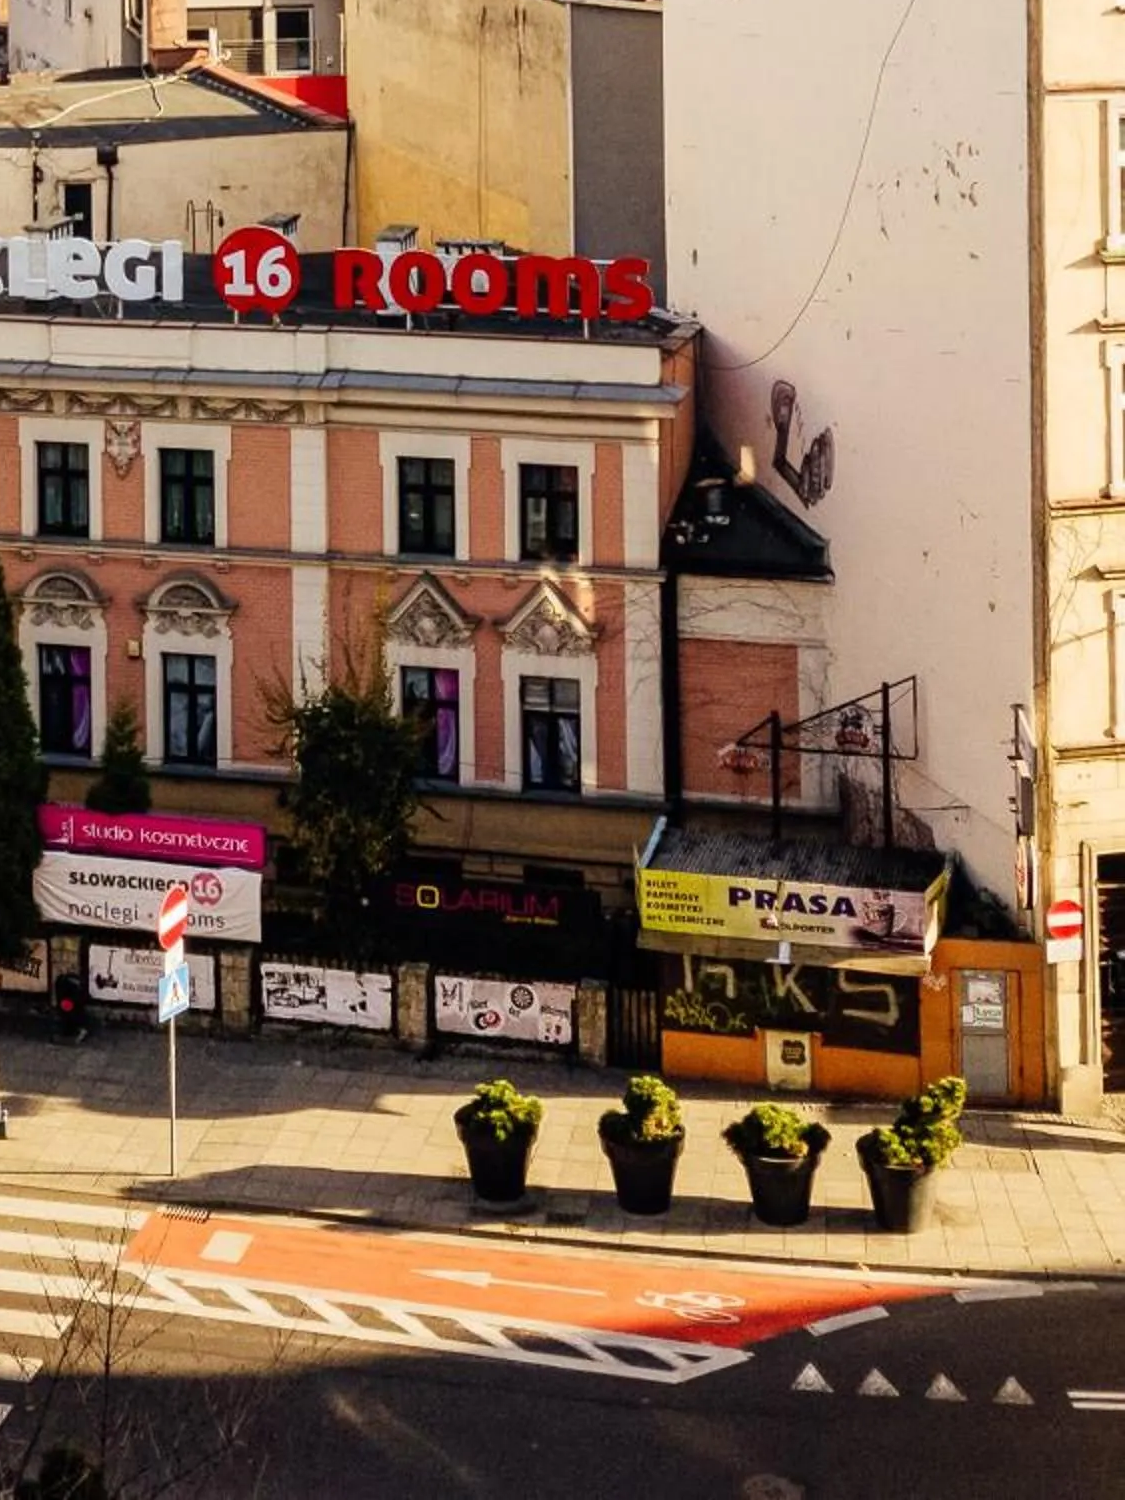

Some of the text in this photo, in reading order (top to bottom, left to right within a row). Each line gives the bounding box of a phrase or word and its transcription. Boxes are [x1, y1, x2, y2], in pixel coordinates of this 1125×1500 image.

[222, 245, 292, 297] 16
[81, 823, 134, 842] studio
[193, 879, 220, 898] 16
[395, 883, 559, 918] SOLARIUM
[68, 900, 139, 924] noclegi
[727, 887, 857, 918] PRASA
